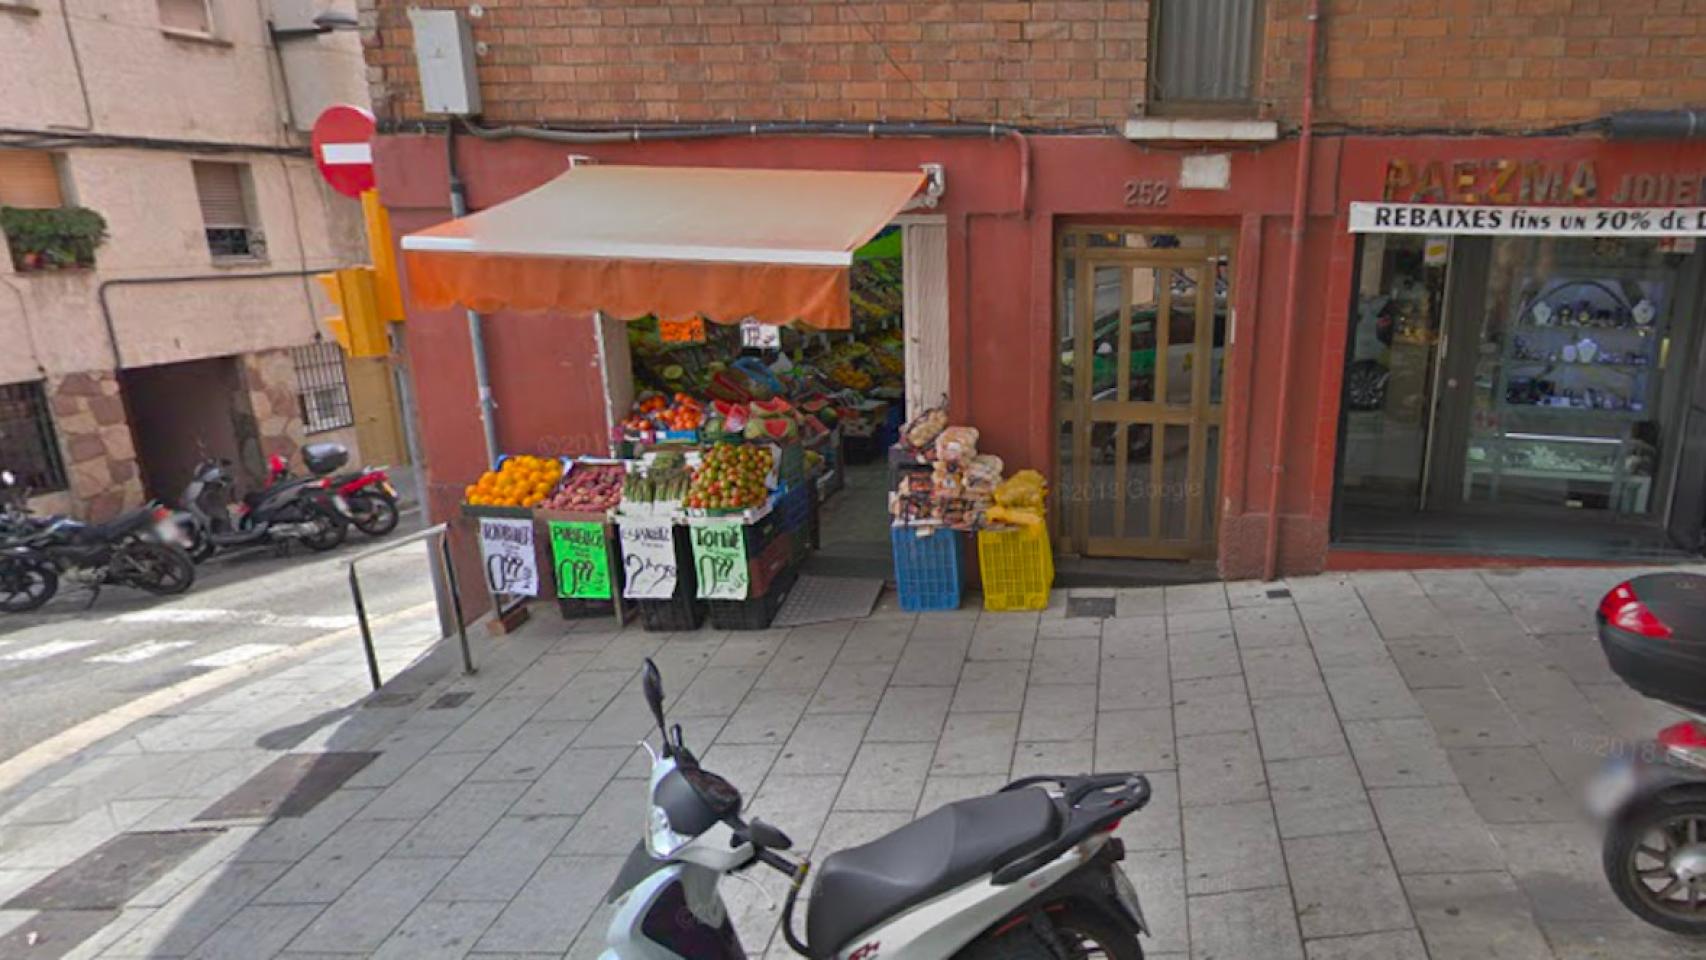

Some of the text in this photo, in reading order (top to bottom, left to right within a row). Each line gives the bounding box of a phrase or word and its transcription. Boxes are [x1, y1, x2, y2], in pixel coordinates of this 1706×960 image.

[1124, 181, 1168, 207] 252
[1384, 158, 1706, 204] PAEZMA JOIE
[1374, 206, 1502, 229] REBAIXES
[1595, 210, 1651, 231] 50%
